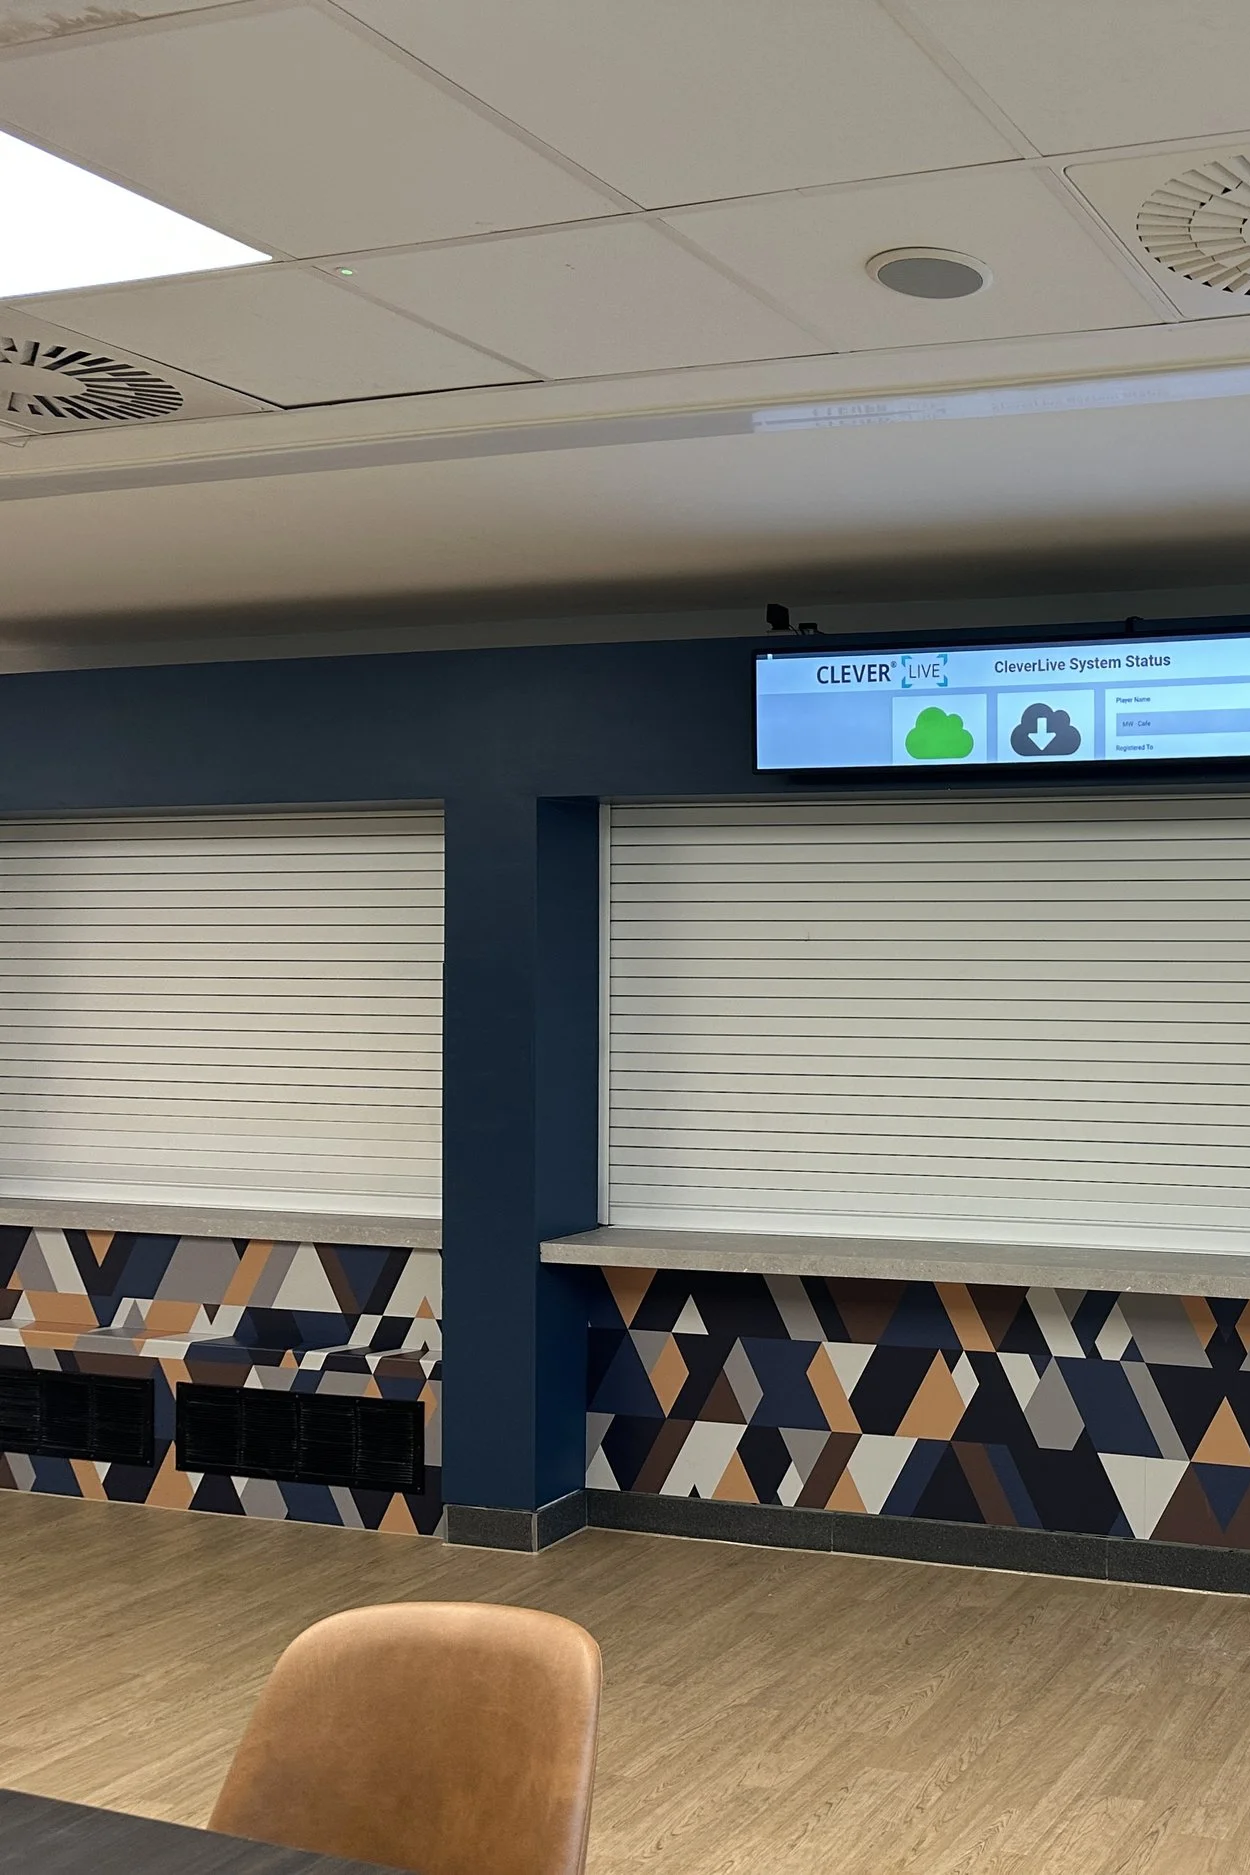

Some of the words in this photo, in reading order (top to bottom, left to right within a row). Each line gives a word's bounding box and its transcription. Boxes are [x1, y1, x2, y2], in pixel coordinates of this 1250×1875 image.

[909, 663, 940, 679] LIVE
[994, 658, 1066, 674] CleverLive
[1069, 656, 1121, 673] System
[1125, 654, 1171, 668] Status
[1116, 744, 1145, 752] Registered
